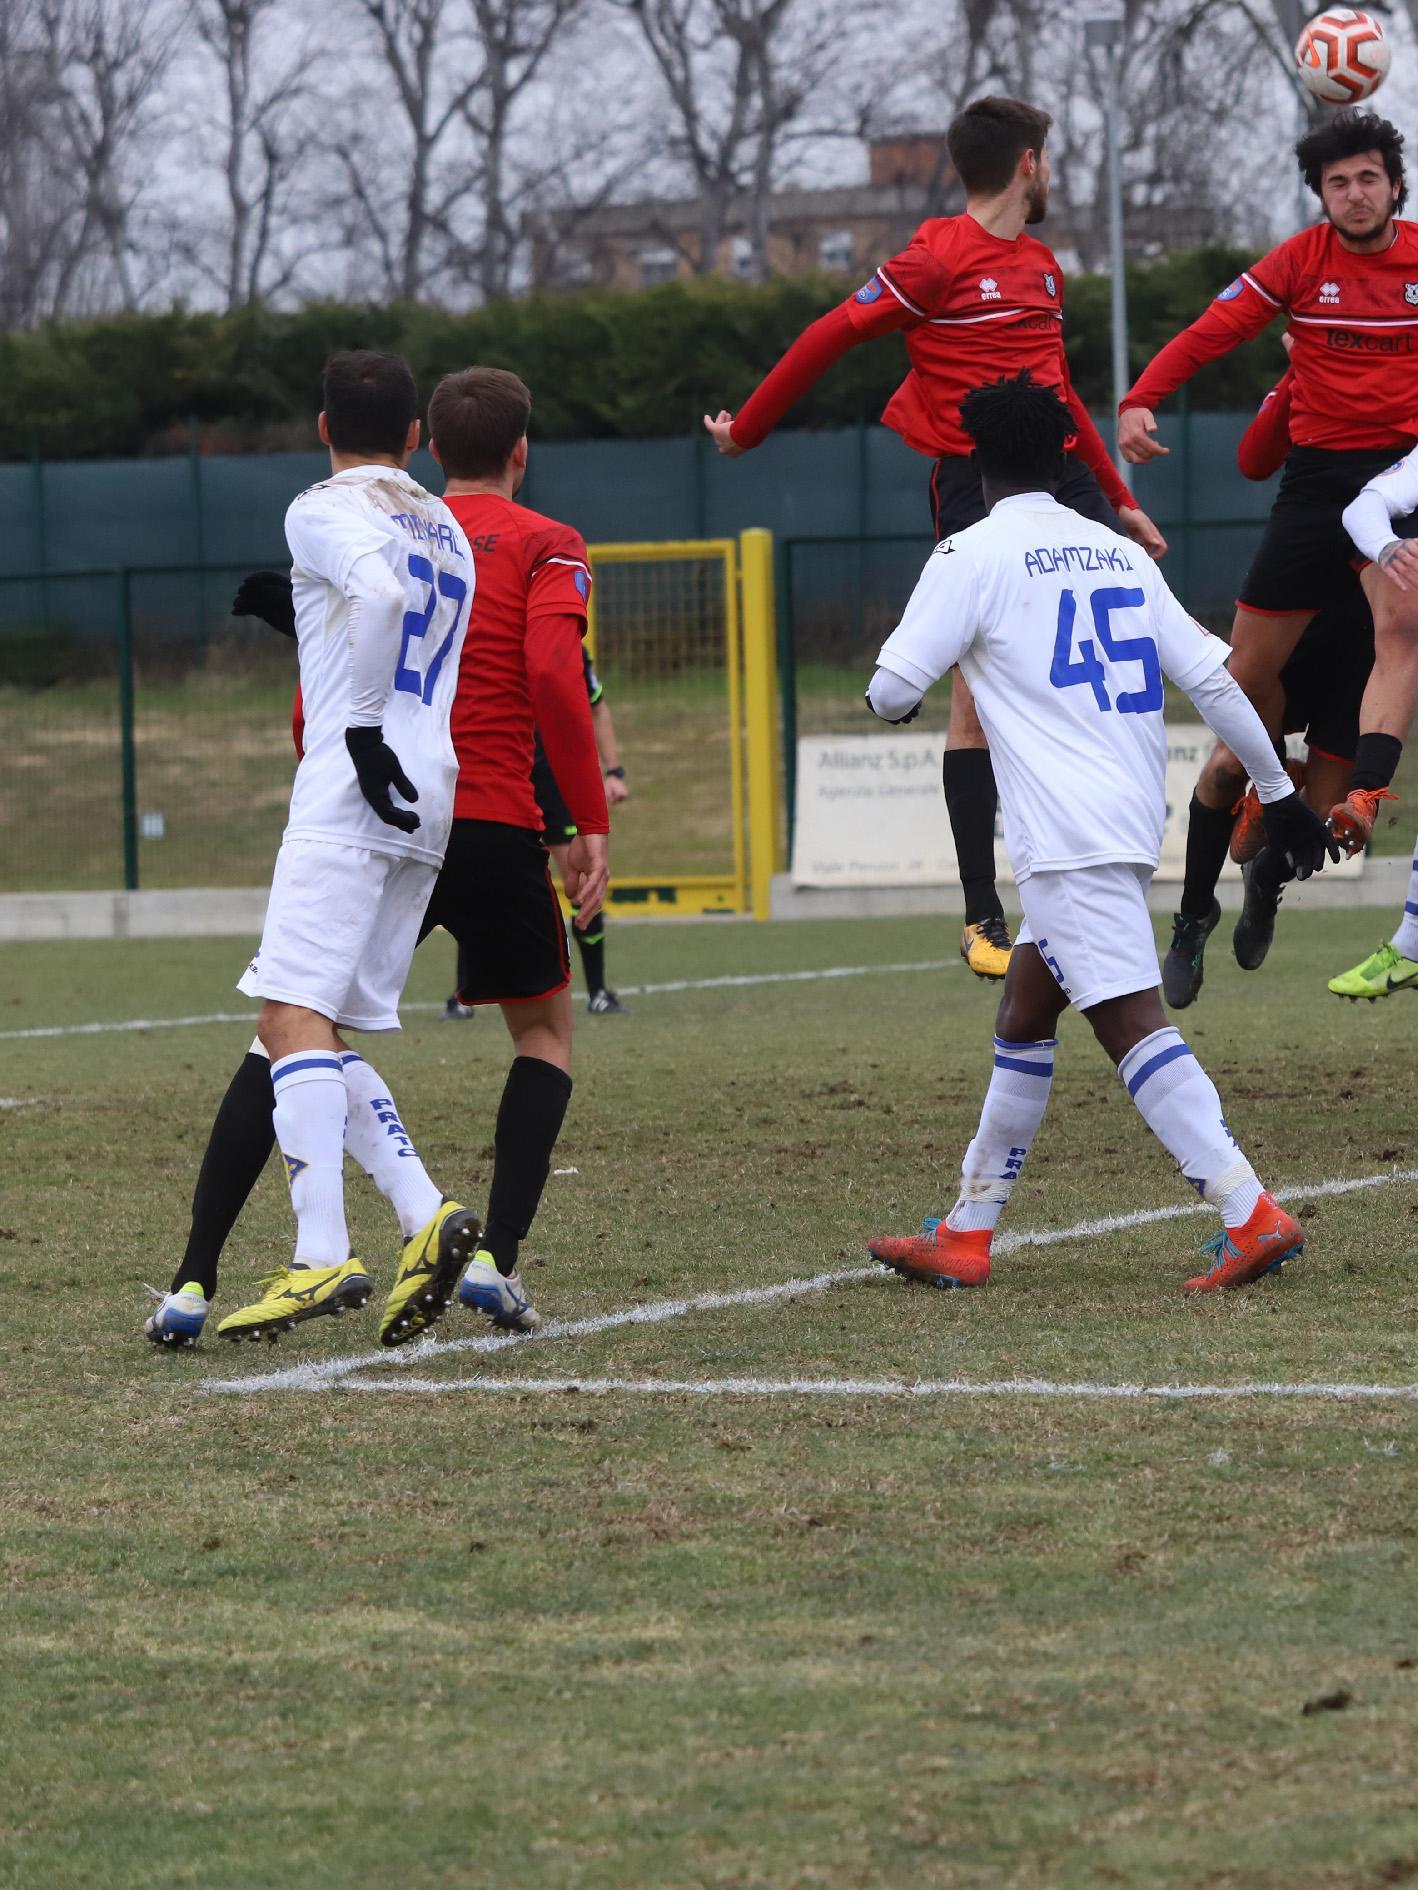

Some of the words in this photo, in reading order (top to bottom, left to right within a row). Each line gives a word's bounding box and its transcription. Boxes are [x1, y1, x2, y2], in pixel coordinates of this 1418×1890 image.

[1326, 328, 1413, 353] texcart
[1025, 546, 1135, 578] ADAMZAKI
[394, 553, 467, 707] 27
[1049, 586, 1164, 714] 45
[818, 750, 882, 770] Allianz
